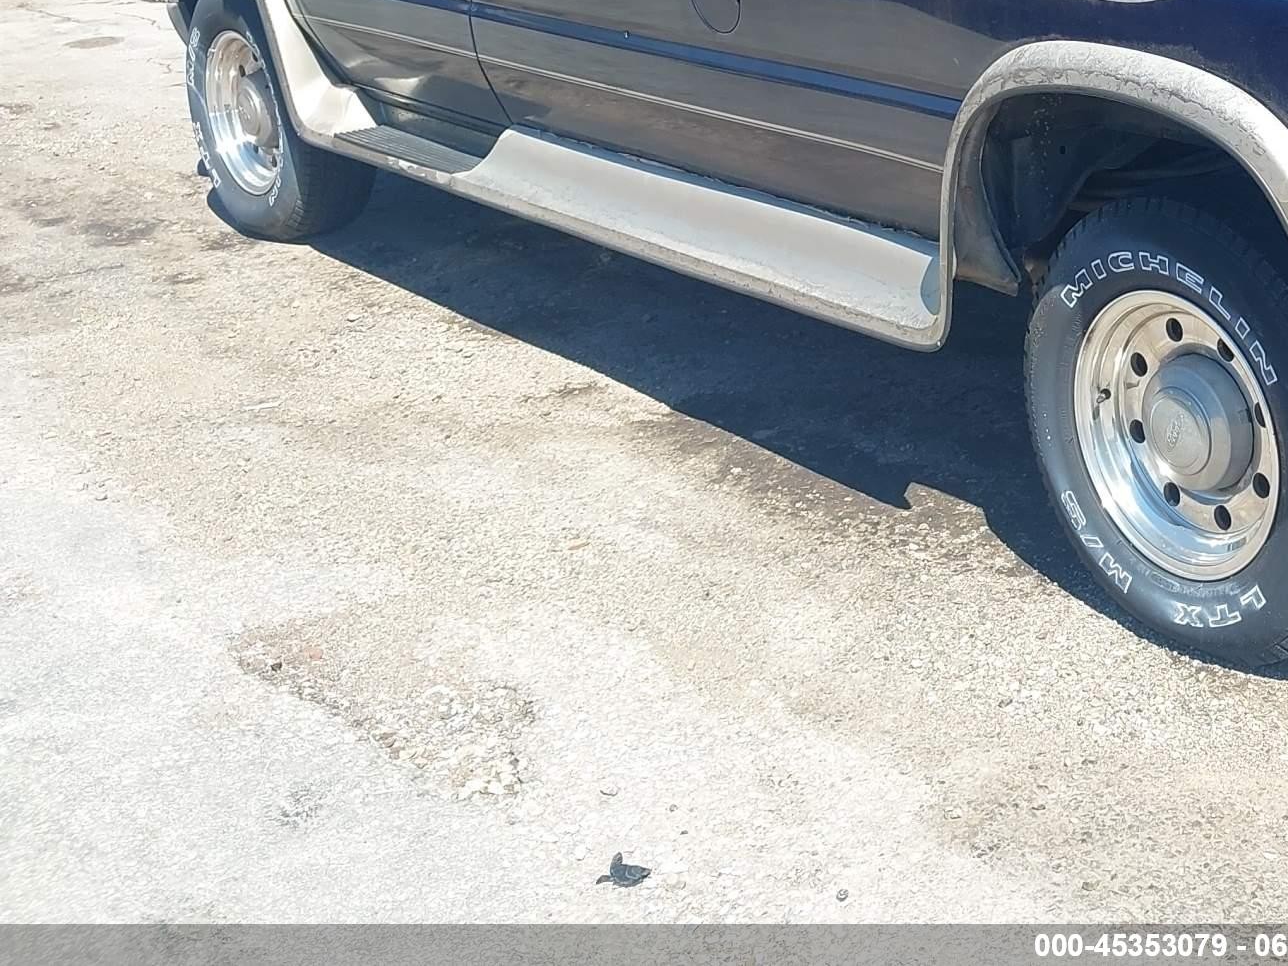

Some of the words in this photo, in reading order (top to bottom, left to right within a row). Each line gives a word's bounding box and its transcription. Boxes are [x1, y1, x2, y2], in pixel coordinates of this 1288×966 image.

[1060, 250, 1279, 386] MICHELIN
[1060, 489, 1134, 595] M/S
[1173, 584, 1268, 628] LTX
